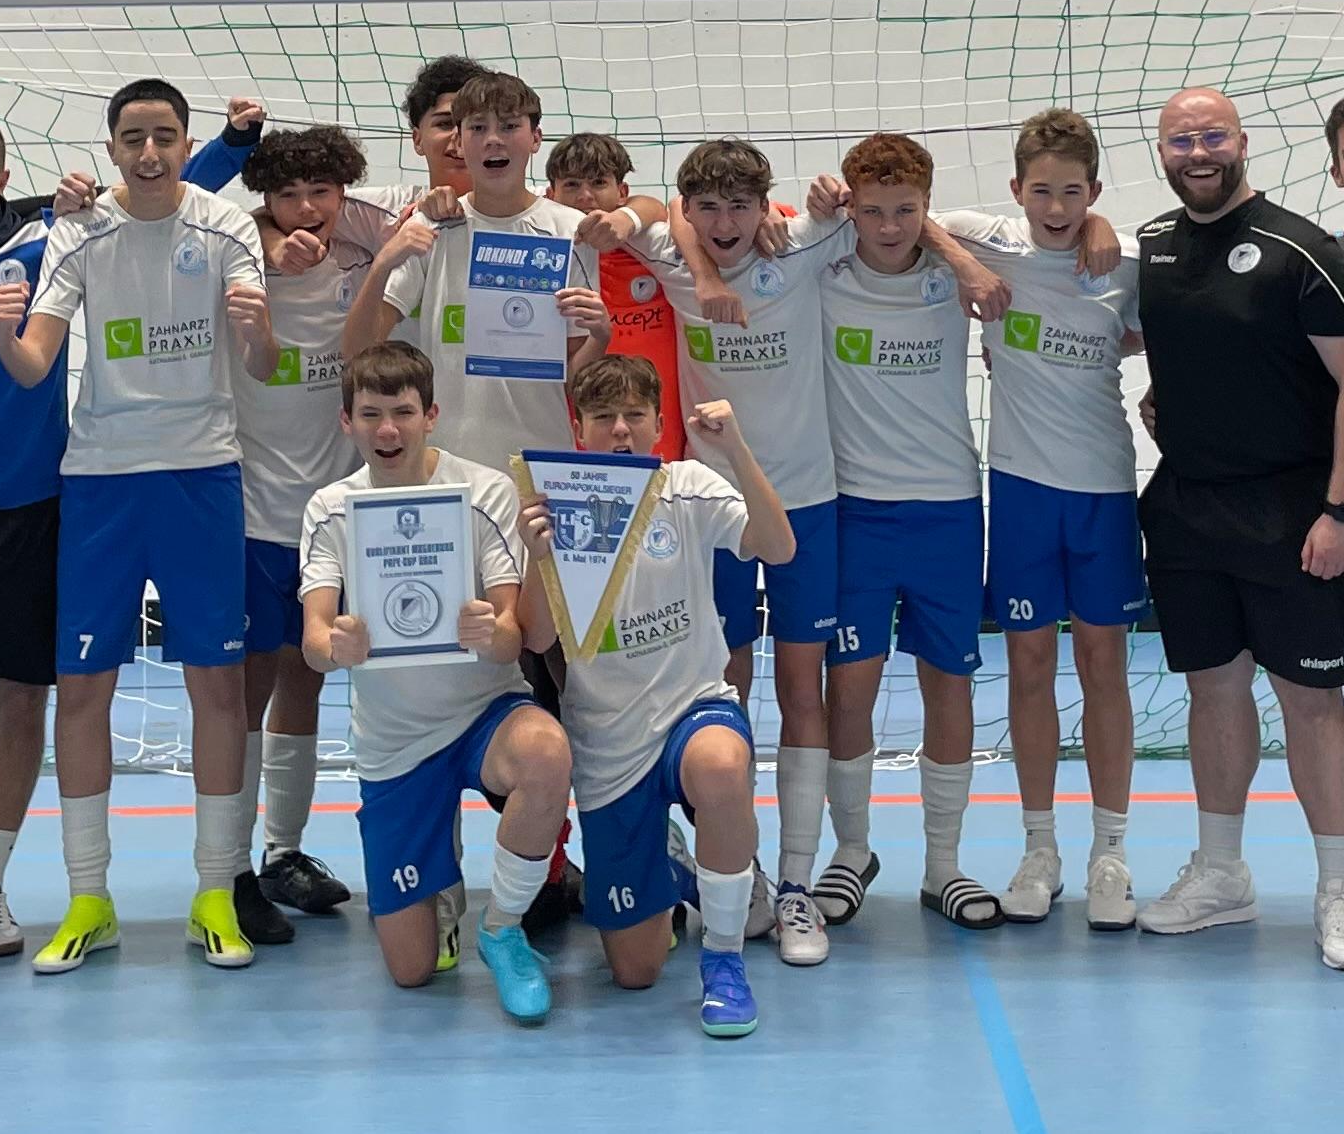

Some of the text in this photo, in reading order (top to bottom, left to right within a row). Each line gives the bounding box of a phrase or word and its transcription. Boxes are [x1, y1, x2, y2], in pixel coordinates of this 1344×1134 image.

[476, 245, 529, 266] URKUNDE
[148, 317, 210, 338] ZAHNARZT
[1044, 326, 1108, 347] ZAHNARZT
[149, 331, 213, 352] PRAXIS
[717, 330, 787, 347] ZAHNARZT
[879, 337, 944, 351] ZAHNARZT
[719, 343, 788, 362] PRAXIS
[878, 350, 942, 365] PRAXIS
[1042, 340, 1105, 363] PRAXIS
[582, 472, 609, 482] JAHRE
[588, 555, 607, 564] 1974
[619, 599, 687, 631] ZAHNARZT
[1008, 597, 1034, 621] 20
[622, 613, 691, 648] PRAXIS
[836, 625, 861, 653] 15
[79, 634, 94, 660] 7
[1300, 656, 1344, 671] uhlsport
[392, 864, 420, 894] 19
[607, 884, 635, 914] 16
